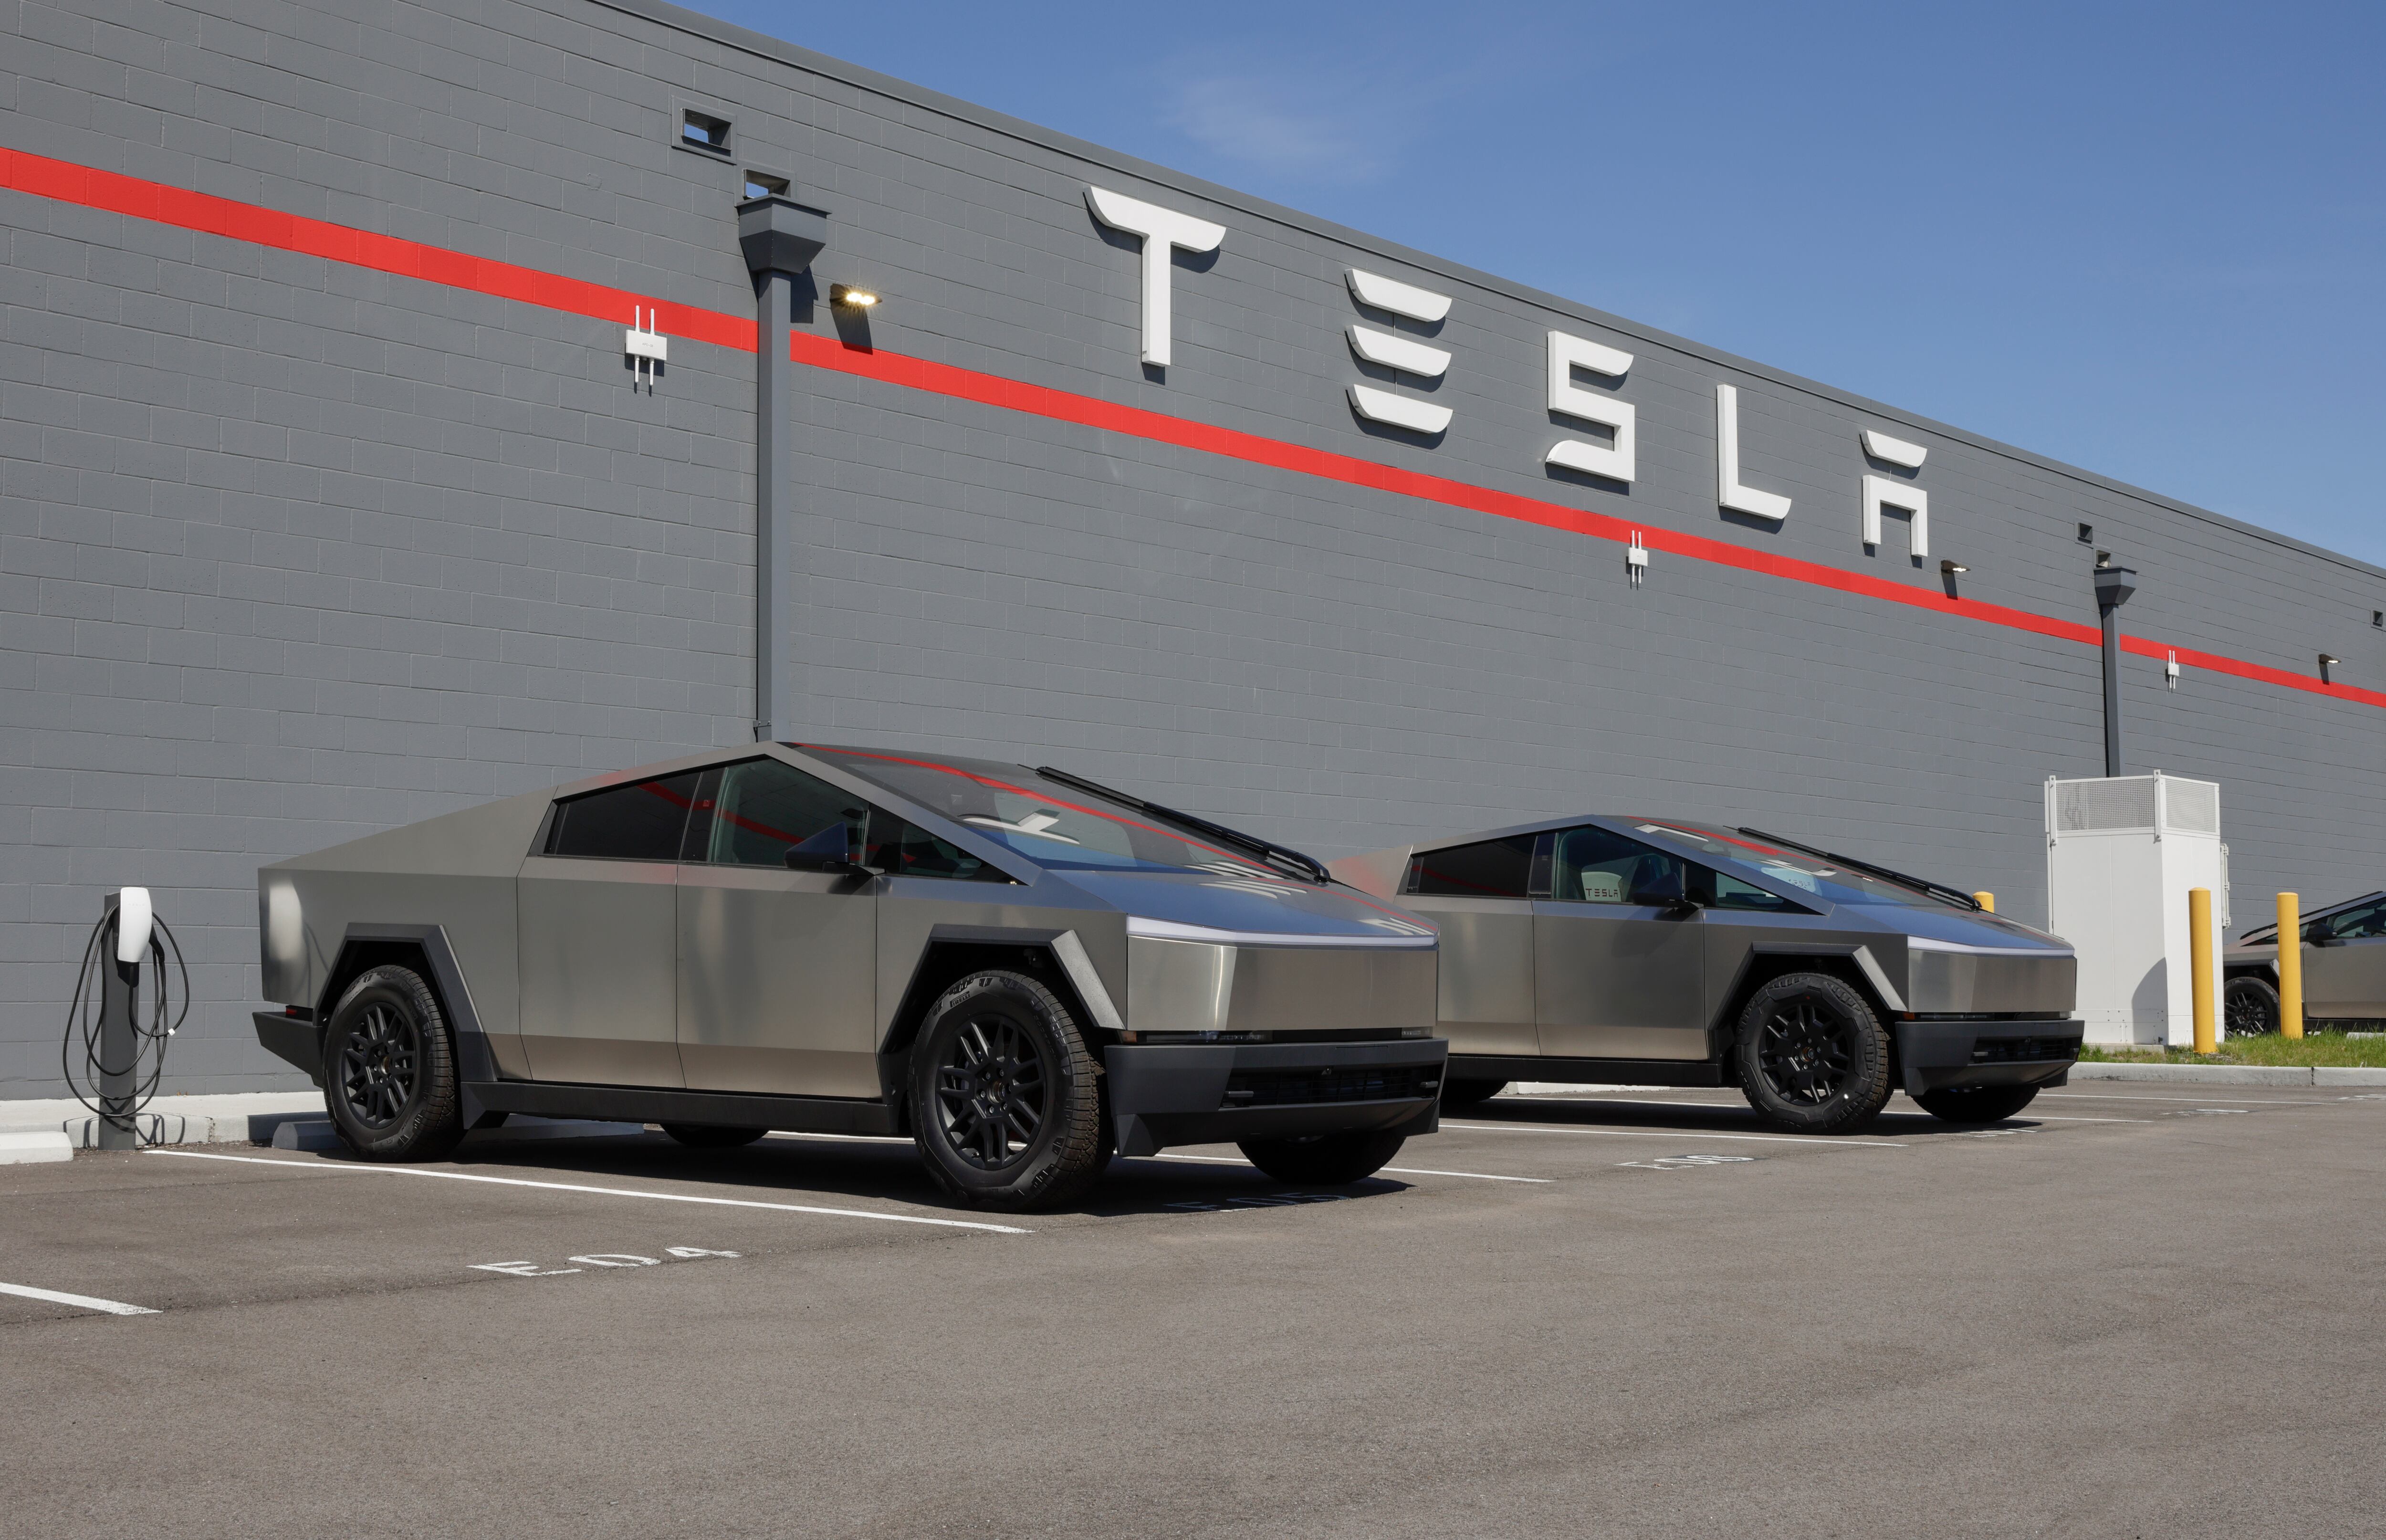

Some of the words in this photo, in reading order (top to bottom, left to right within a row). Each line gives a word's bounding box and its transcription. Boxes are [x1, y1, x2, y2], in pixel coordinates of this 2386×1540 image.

[1084, 186, 1928, 557] TESLA
[1585, 888, 1618, 898] TESLA
[950, 990, 970, 1008] PIRELLI
[1162, 1192, 1351, 1212] E05
[466, 1247, 742, 1276] E04
